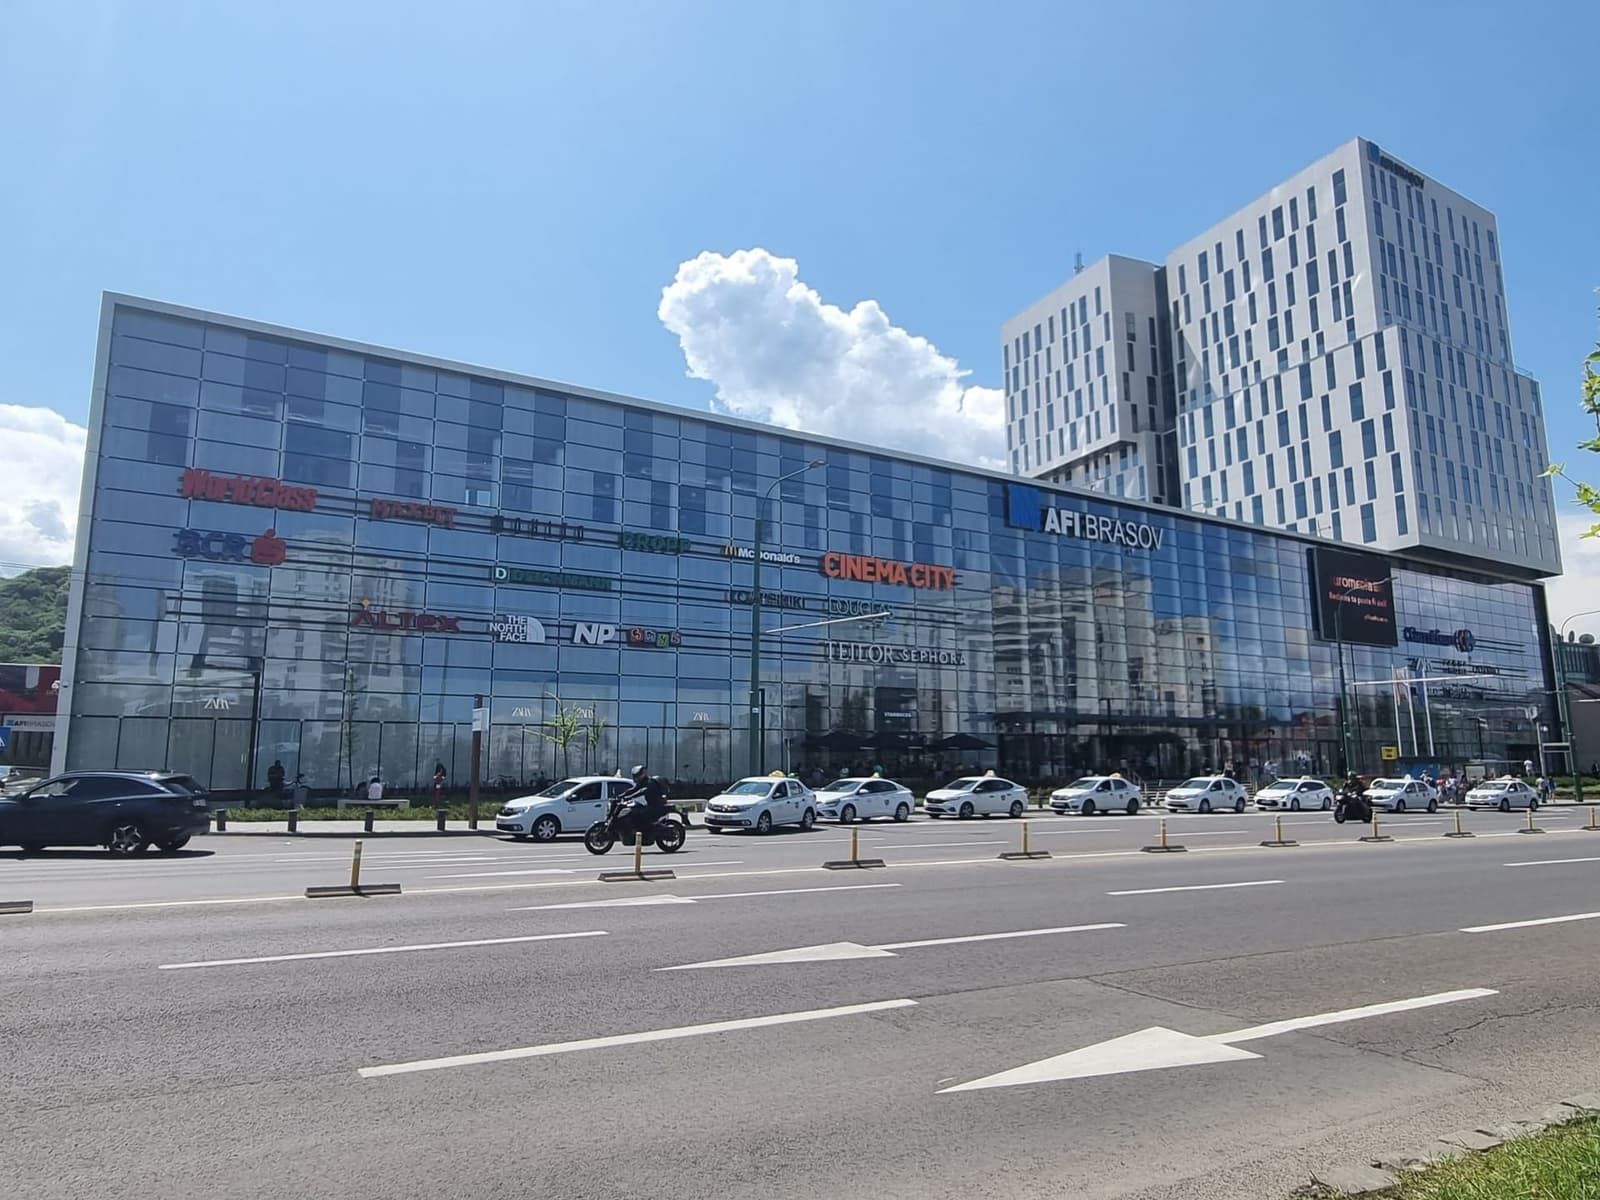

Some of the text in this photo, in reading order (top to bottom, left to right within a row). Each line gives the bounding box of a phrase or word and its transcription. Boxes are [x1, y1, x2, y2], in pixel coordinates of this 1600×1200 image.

[1045, 507, 1163, 550] AFI BRASOV
[176, 530, 247, 560] BCR
[821, 551, 956, 592] CINEMA CITY
[489, 622, 527, 633] NORTH
[507, 615, 527, 624] THE
[500, 631, 527, 642] FACE
[573, 623, 616, 645] NP
[824, 640, 895, 663] TEILOR
[902, 649, 967, 666] SEPHORA
